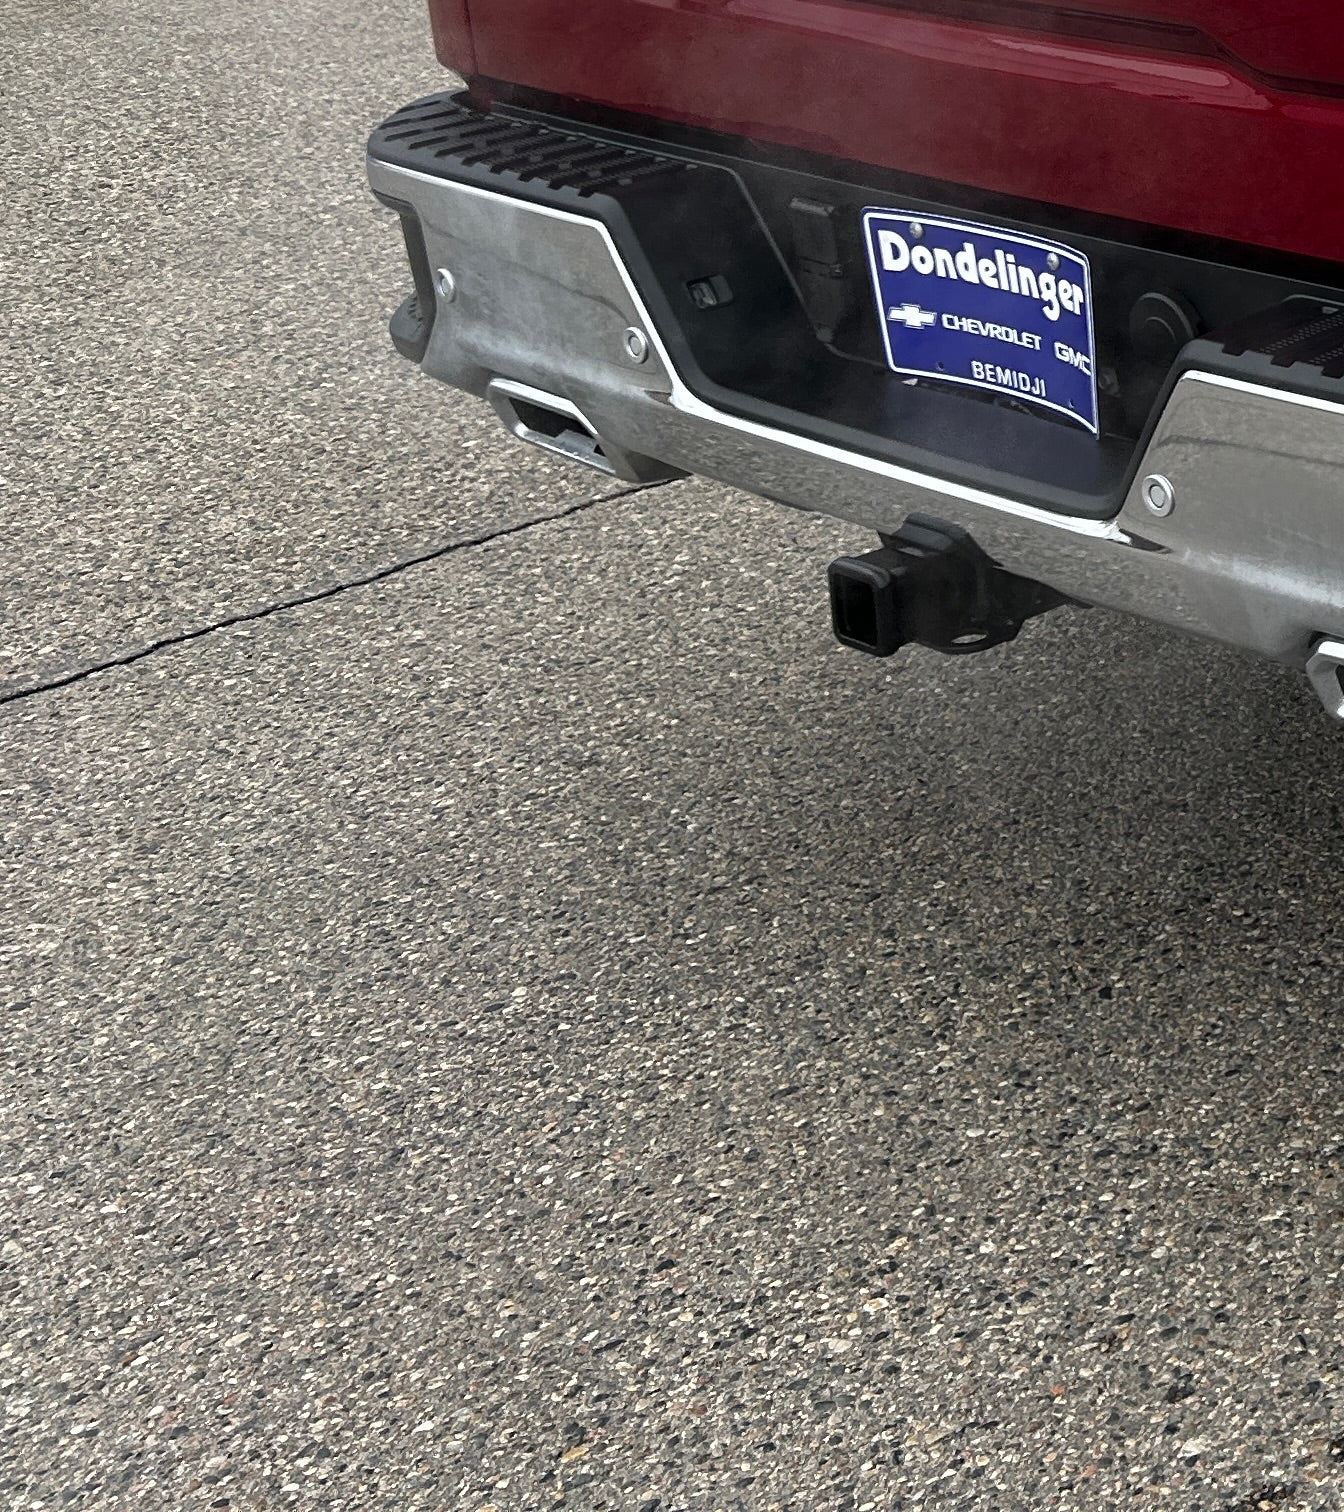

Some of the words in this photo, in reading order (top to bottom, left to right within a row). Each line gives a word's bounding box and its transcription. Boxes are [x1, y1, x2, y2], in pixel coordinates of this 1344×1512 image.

[877, 229, 1085, 322] Dondelinger
[941, 313, 1042, 351] CHEVROLET
[1053, 341, 1092, 376] GMC
[970, 360, 1047, 398] BEMIDJI
